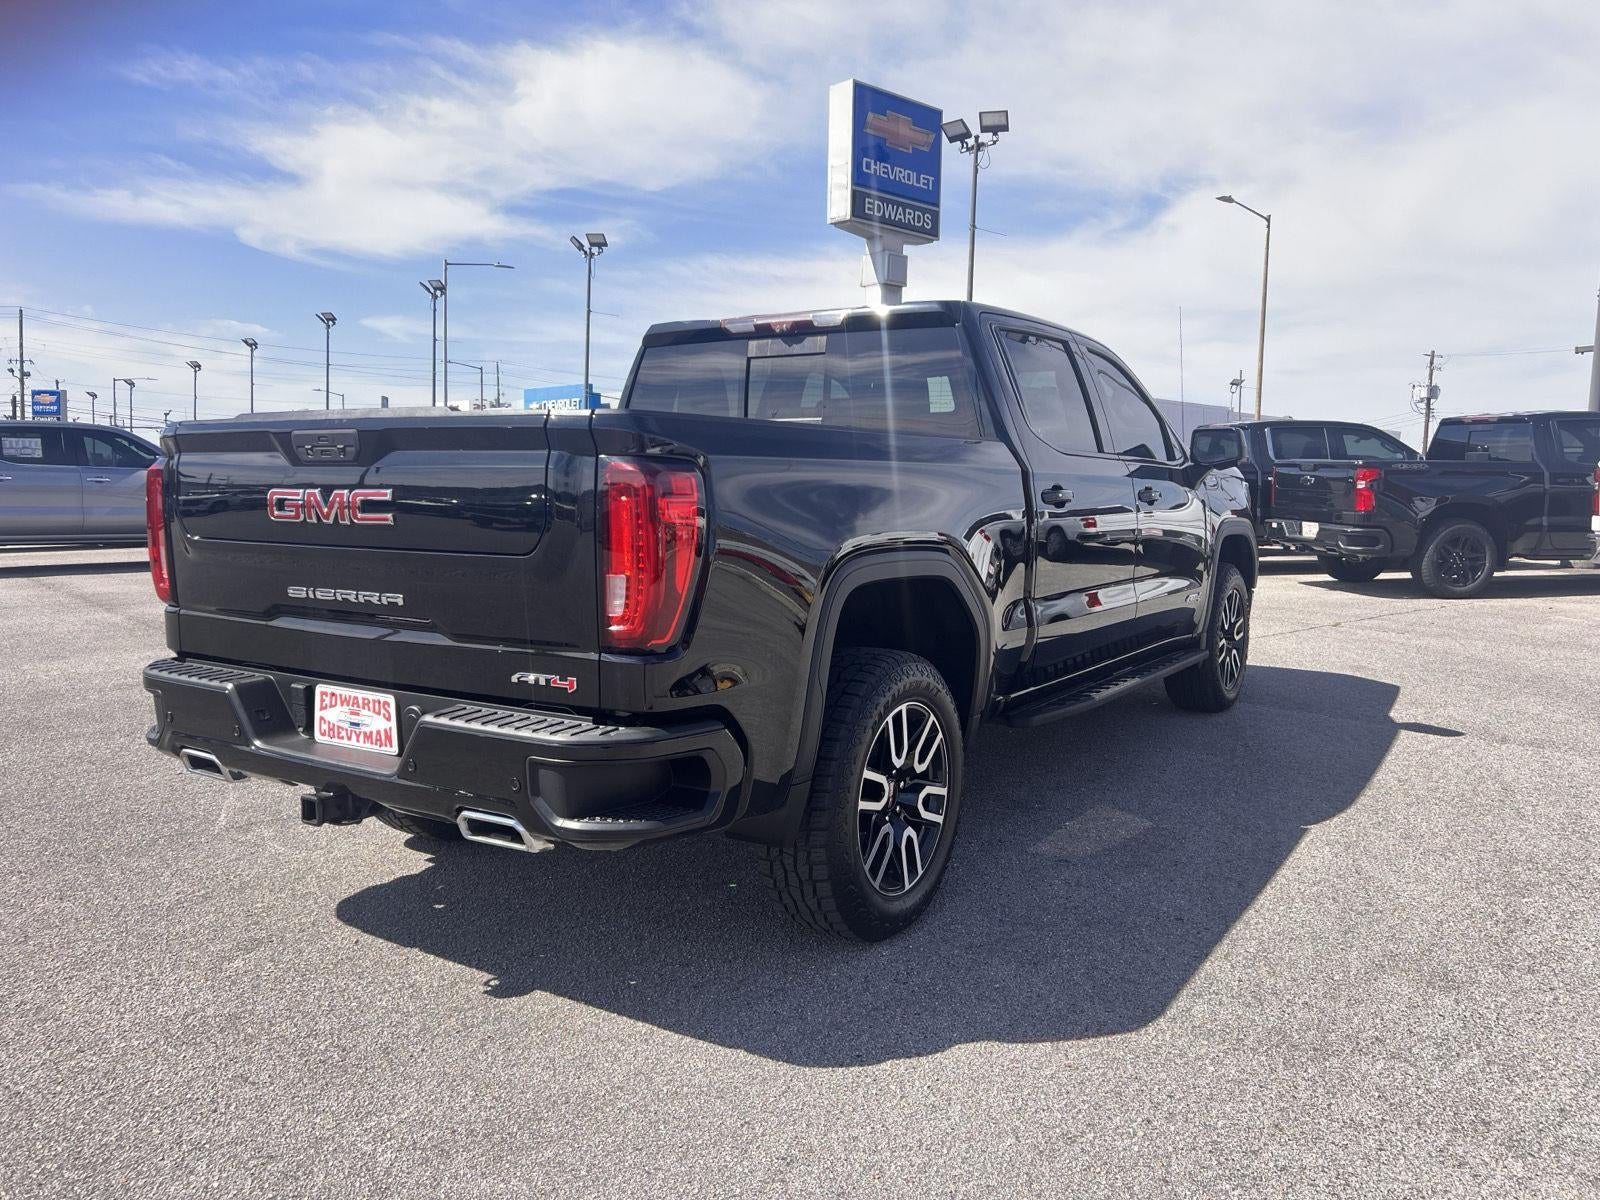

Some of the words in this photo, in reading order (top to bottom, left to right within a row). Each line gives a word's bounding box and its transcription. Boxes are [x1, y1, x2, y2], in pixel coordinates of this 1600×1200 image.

[862, 157, 934, 190] CHEVROLET
[864, 198, 932, 229] EDWARDS
[541, 398, 580, 410] CHEVROLET
[267, 488, 394, 525] GMC
[287, 586, 405, 606] SIERRA
[511, 672, 577, 693] AT4
[319, 691, 392, 722] EDWARDS
[319, 716, 393, 748] CHEVYMAN
